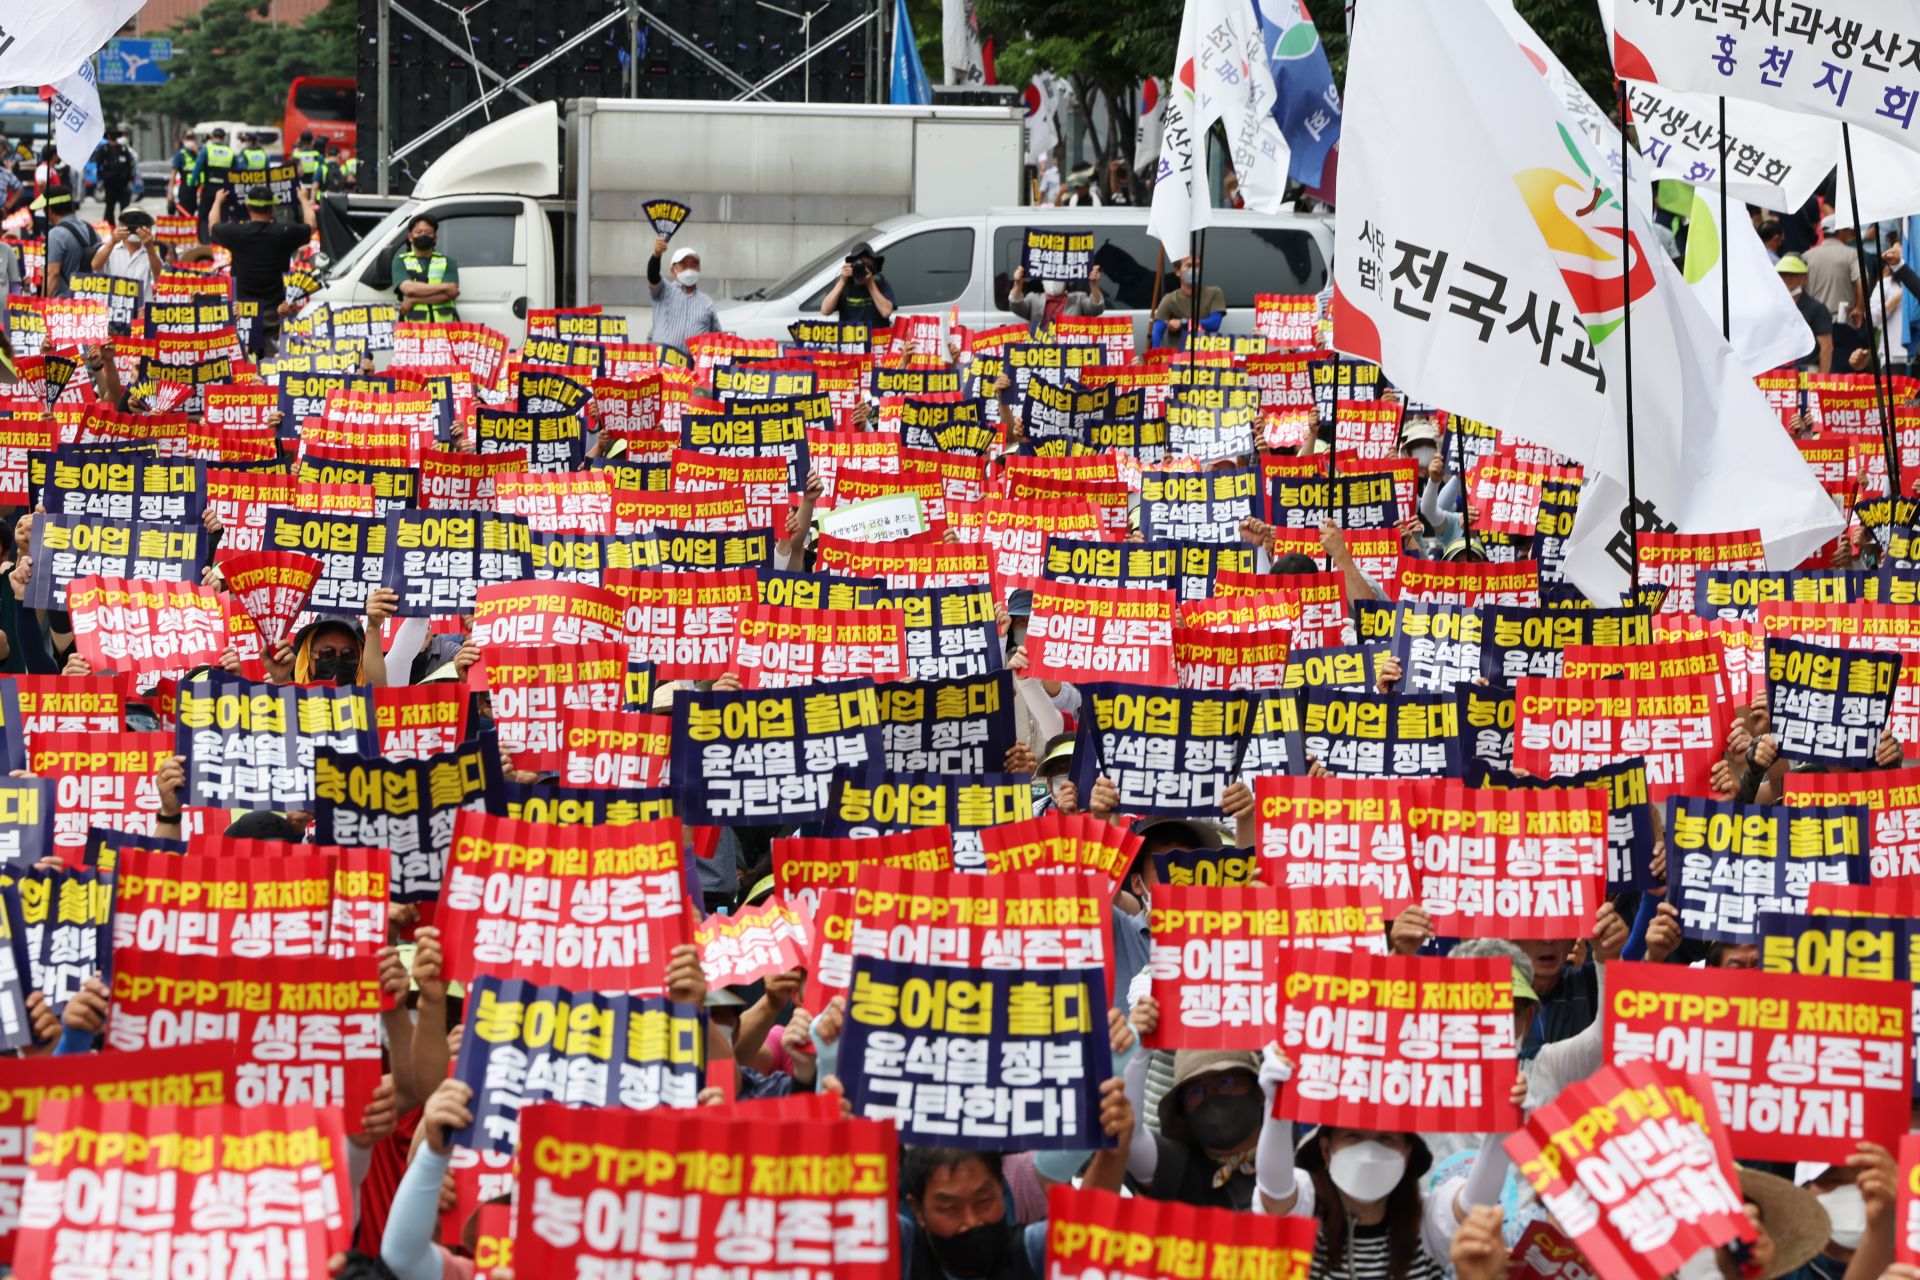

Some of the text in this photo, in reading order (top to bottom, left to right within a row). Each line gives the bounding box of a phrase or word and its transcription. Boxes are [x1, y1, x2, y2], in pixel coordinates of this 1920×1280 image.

[1028, 232, 1094, 251] 농어업 홀대
[1029, 263, 1088, 278] 규탄한다!
[1030, 251, 1089, 263] 윤석열 정부
[70, 276, 110, 293] 농어업
[151, 304, 228, 323] 농어업 홀대
[333, 309, 367, 325] 농어업
[559, 318, 628, 334] 농어업 홀대
[799, 324, 838, 343] 농어업
[1057, 324, 1133, 334] CPTPP가입 저지하고
[159, 340, 207, 350] CPTPP가입
[524, 340, 569, 361] 농어업
[1009, 347, 1100, 367] 농어업 홀대
[1185, 335, 1266, 354] 농어업 홀대
[147, 360, 229, 383] 농어업 홀대
[716, 373, 812, 393] 농어업 홀대
[878, 373, 958, 392] 농어업 홀대
[1219, 369, 1248, 386] 홀대
[209, 393, 258, 405] CPTPP가입
[286, 377, 344, 397] 농어업
[331, 396, 392, 413] CPTPP가입
[539, 416, 578, 440] 홀대
[690, 418, 804, 444] 농어업 홀대
[54, 462, 195, 493] 농어업 홀대
[372, 470, 413, 497] 홀대
[1142, 474, 1255, 501] 농어업 홀대
[64, 493, 185, 519] 윤석열 정부
[1281, 480, 1392, 506] 농어업 홀대
[695, 500, 745, 515] 저지하고
[1151, 500, 1250, 522] 윤석열 정부
[1348, 506, 1384, 529] 정부
[43, 522, 197, 560] 농어업 홀대
[275, 518, 357, 552] 농어업
[397, 518, 531, 552] 농어업 홀대
[53, 553, 126, 576] 윤석열
[404, 551, 521, 579] 윤석열 정부
[852, 555, 988, 572] CPTPP가입 저지하고
[1048, 546, 1176, 576] 농어업 홀대
[1640, 546, 1715, 561] CPTPP가입
[697, 586, 752, 604] 저지하고
[1402, 571, 1482, 591] CPTPP가입
[1707, 577, 1847, 605] 농어업 홀대
[70, 588, 164, 609] CPTPP가입
[1033, 595, 1113, 614] CPTPP가입
[740, 619, 897, 643] CPTPP가입 저지하고
[1028, 612, 1171, 646] 농어민 생존권
[1495, 614, 1649, 647] 농어업 홀대
[1764, 617, 1858, 633] CPTPP가입
[100, 630, 217, 660] 쟁취하자!
[737, 642, 900, 674] 농어민 생존권
[1044, 642, 1149, 671] 쟁취하자!
[1660, 654, 1719, 676] 저지하고
[42, 693, 119, 713] 저지하고
[181, 691, 367, 732] 농어업 홀대
[688, 688, 880, 740] 농어업 홀대
[1523, 696, 1710, 717] CPTPP가입 저지하고
[932, 720, 988, 748] 정부
[1397, 704, 1458, 739] 홀대
[1522, 717, 1713, 752] 농어민 생존권
[194, 731, 286, 766] 윤석열
[568, 728, 670, 755] CPTPP가입
[702, 734, 868, 777] 윤석열 정부
[34, 752, 147, 773] CPTPP가입
[567, 750, 647, 788] 농어민
[1393, 743, 1447, 773] 정부
[840, 781, 1032, 825] 농어업 홀대
[1263, 797, 1384, 821] CPTPP가입
[1527, 811, 1603, 835] 저지하고
[1675, 809, 1859, 858] 농어업 홀대
[1262, 823, 1360, 859] 농어민
[456, 837, 677, 876] CPTPP가입 저지하고
[1506, 838, 1603, 876] 생존권
[1682, 853, 1774, 896] 윤석열
[448, 866, 682, 923] 농어민 생존권
[855, 889, 1101, 925] CPTPP가입 저지하고
[1420, 877, 1585, 917] 쟁취하자!
[1150, 907, 1384, 935] CPTPP가입 저지하고
[473, 920, 649, 968] 쟁취하자!
[981, 928, 1105, 969] 생존권
[1148, 939, 1262, 981] 농어민
[115, 974, 381, 1011] CPTPP가입 저지하고
[851, 972, 1091, 1035] 농어업 홀대
[1286, 972, 1513, 1009] CPTPP가입 저지하고
[475, 990, 614, 1059] 농어업
[1614, 990, 1903, 1037] CPTPP가입 저지하고
[252, 1014, 382, 1061] 생존권
[1284, 1005, 1515, 1059] 농어민 생존권
[864, 1032, 1084, 1085] 윤석열 정부
[1767, 1035, 1903, 1090] 생존권
[1297, 1054, 1482, 1107] 쟁취하자!
[864, 1078, 1077, 1138] 규탄한다!
[534, 1137, 743, 1195] CPTPP가입
[21, 1169, 176, 1231] 농어민
[532, 1179, 888, 1264] 농어민 생존권
